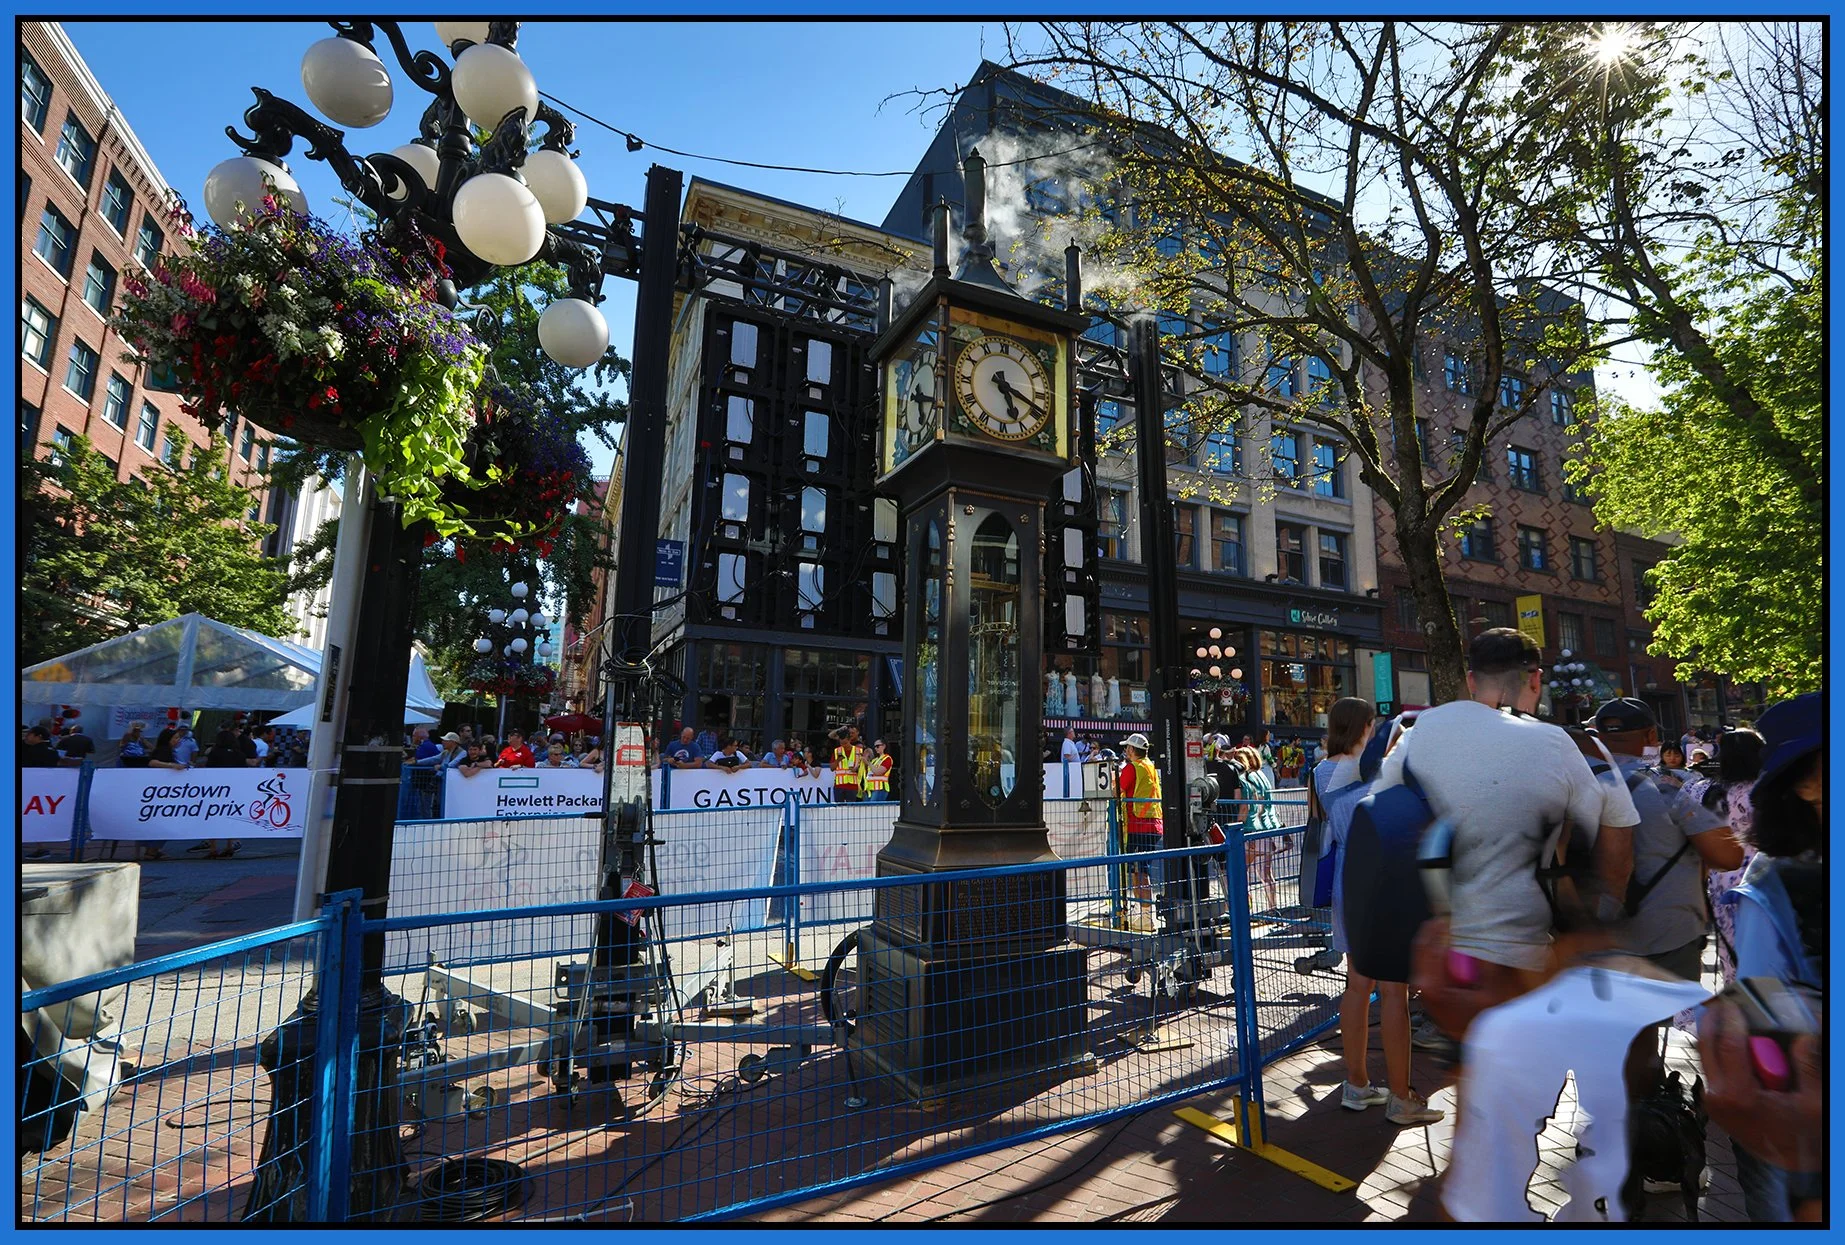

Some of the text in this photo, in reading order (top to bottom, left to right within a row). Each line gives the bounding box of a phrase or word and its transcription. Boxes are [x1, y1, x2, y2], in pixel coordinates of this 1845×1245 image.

[1098, 762, 1109, 790] 5
[140, 782, 231, 802] gastown
[496, 794, 604, 806] Hewlett Packar
[693, 787, 831, 808] GASTOWN
[138, 800, 245, 821] grand prix
